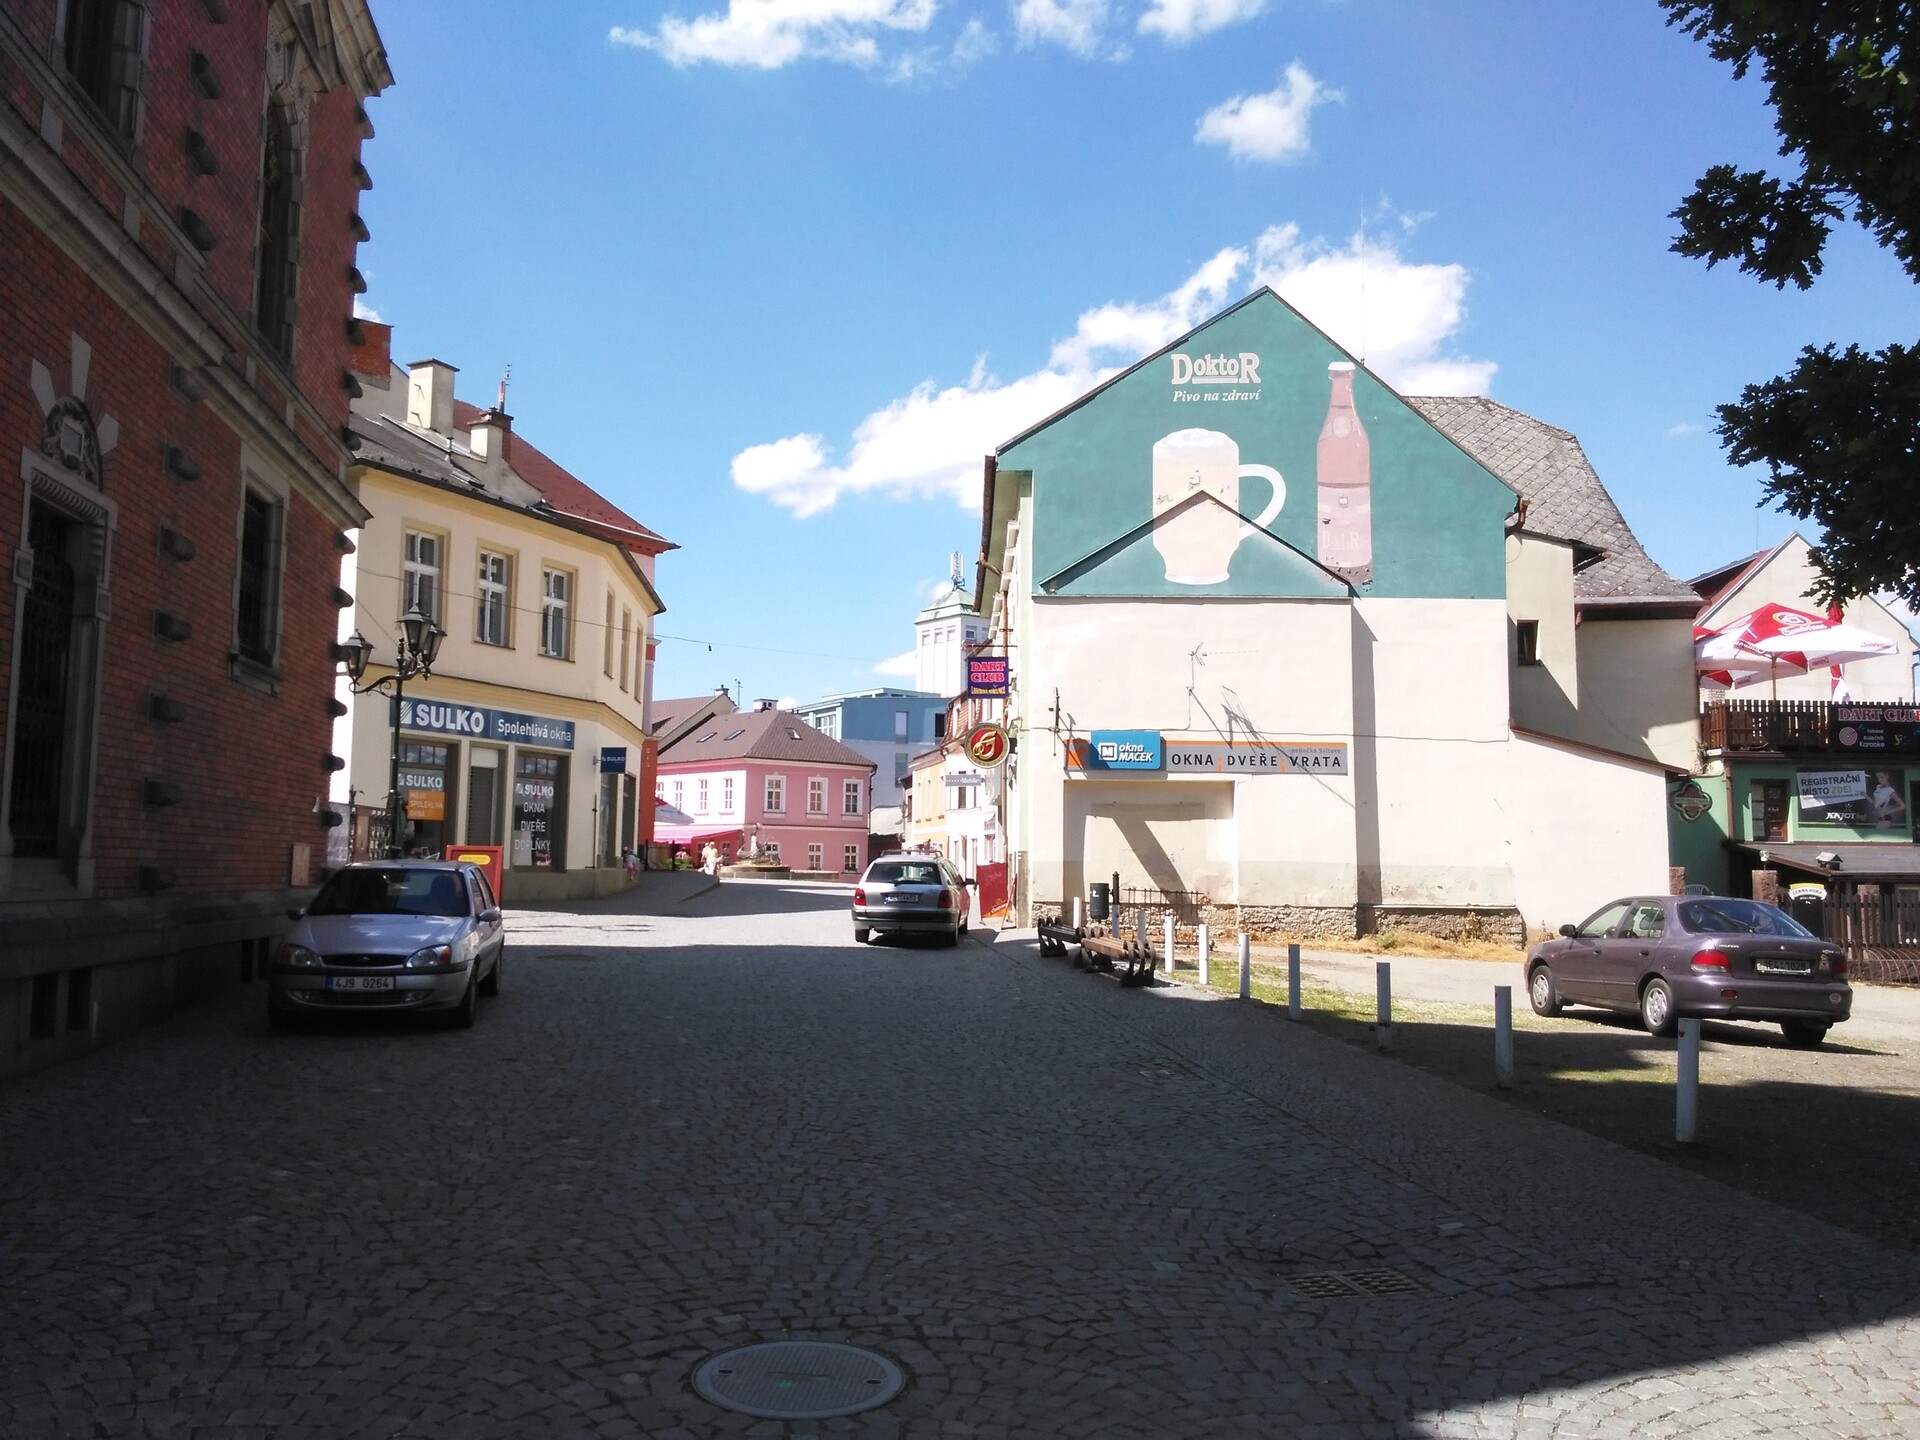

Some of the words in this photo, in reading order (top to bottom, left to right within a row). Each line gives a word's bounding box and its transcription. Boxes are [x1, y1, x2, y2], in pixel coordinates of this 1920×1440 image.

[1170, 352, 1262, 385] DoktoR
[1173, 390, 1200, 402] Pivo
[1203, 391, 1220, 402] na
[1222, 389, 1262, 402] zdraví
[970, 661, 1005, 672] DART
[970, 672, 1005, 683] CLUB
[1837, 707, 1882, 722] DART
[415, 703, 485, 733] SULKO
[497, 718, 548, 739] Spolehlivá
[550, 726, 572, 742] okna
[1119, 742, 1144, 752] okna
[1171, 753, 1214, 766] OKNA
[1227, 752, 1278, 767] DVEŘE
[1289, 756, 1342, 768] VRATA
[405, 774, 443, 789] SULKO
[1801, 773, 1861, 787] REGISTRAČNÍ
[524, 783, 554, 797] SULKO
[1802, 786, 1829, 796] MÍSTO
[523, 801, 546, 813] OKNA
[520, 818, 546, 832] DVEŘE
[514, 837, 551, 851] DOPLŇKY
[335, 978, 355, 989] 4J9
[362, 978, 390, 989] 0264
